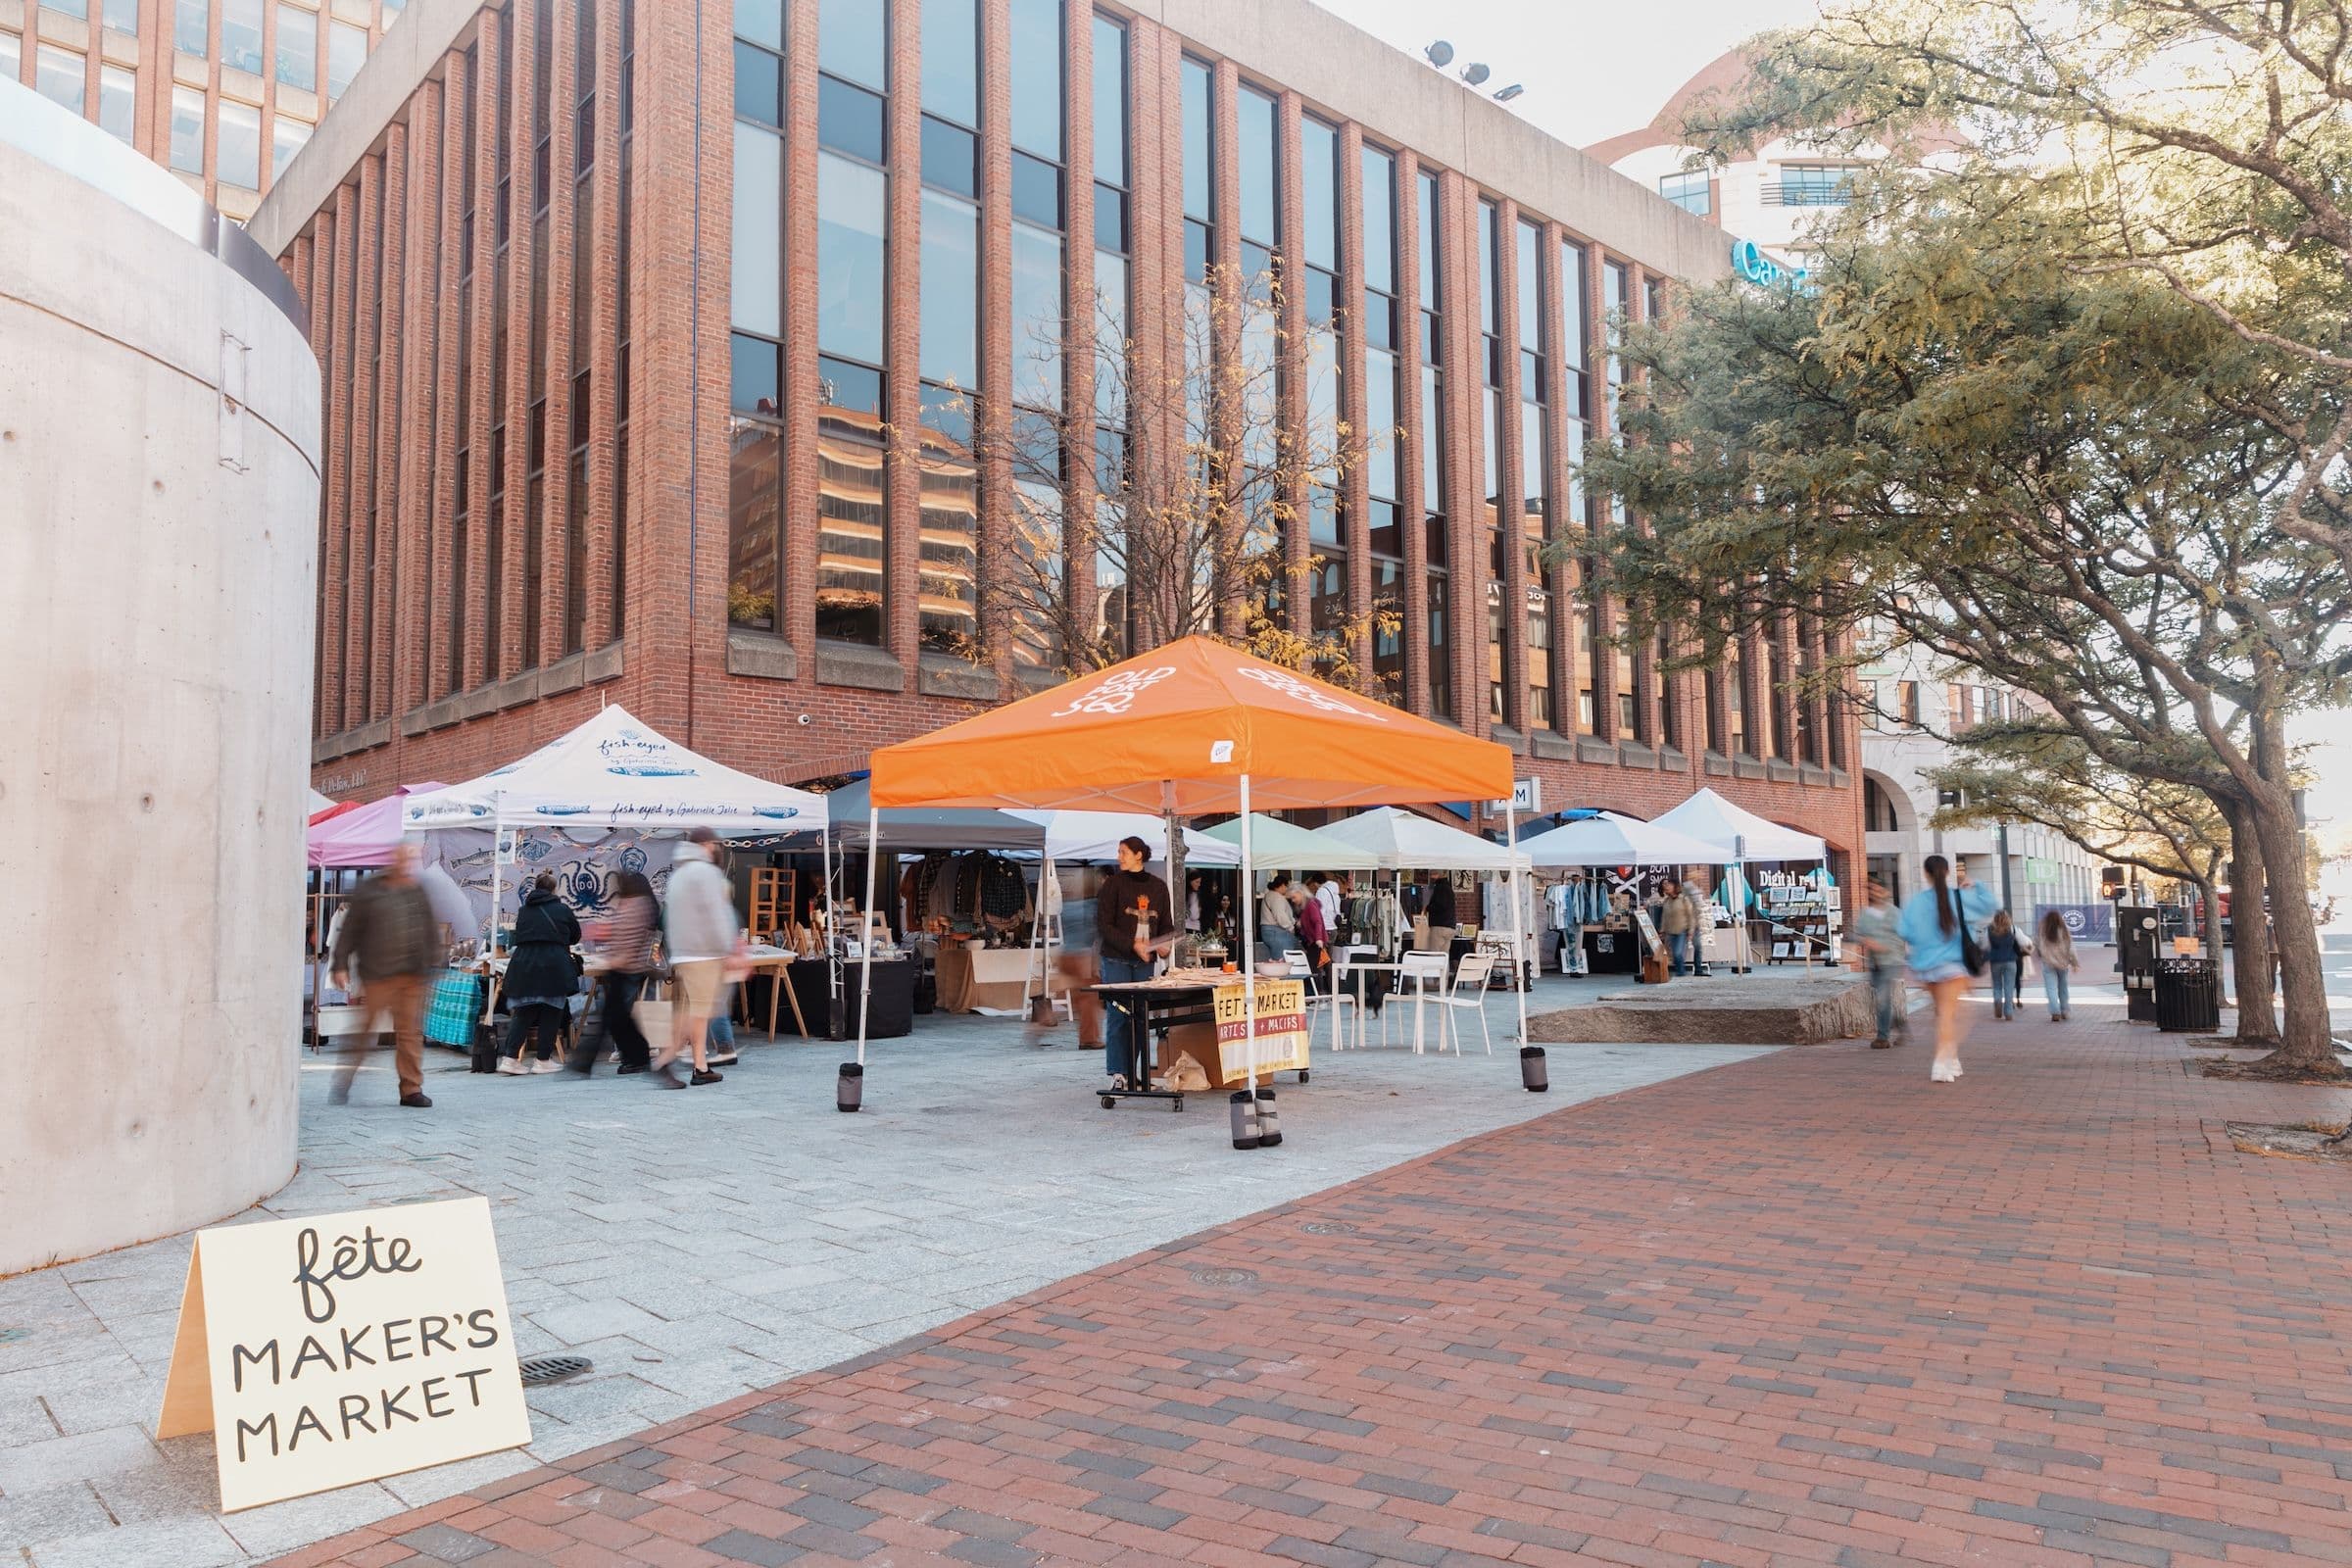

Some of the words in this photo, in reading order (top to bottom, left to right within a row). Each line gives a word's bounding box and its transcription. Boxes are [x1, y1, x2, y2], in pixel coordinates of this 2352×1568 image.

[1103, 666, 1176, 686] OLD
[610, 803, 662, 823] fish-eyed
[1759, 869, 1796, 887] Digital
[2034, 863, 2055, 879] TD
[1257, 992, 1298, 1013] MARKET
[1220, 1024, 1248, 1038] ARTIS
[292, 1225, 422, 1323] fête
[232, 1308, 499, 1393] MAKER'S
[236, 1367, 493, 1462] MARKET
